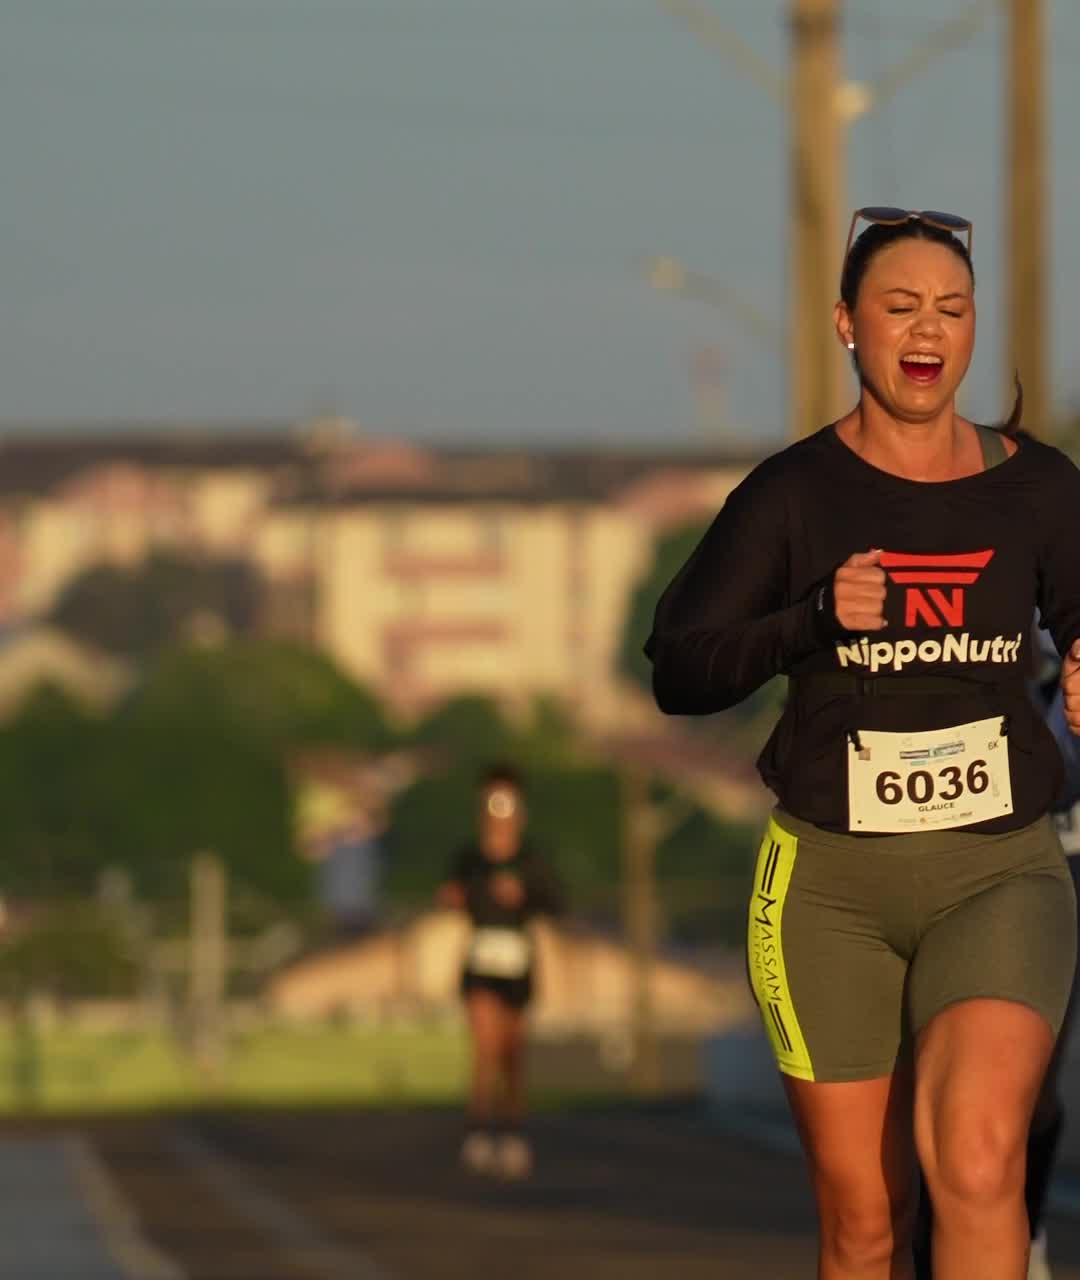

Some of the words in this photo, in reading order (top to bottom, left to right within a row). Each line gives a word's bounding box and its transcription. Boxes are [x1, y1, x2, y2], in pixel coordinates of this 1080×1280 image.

[836, 633, 1021, 672] NippoNutri
[875, 759, 989, 806] 6036
[918, 802, 955, 813] GLAUCE
[754, 894, 783, 1002] MASSAM
